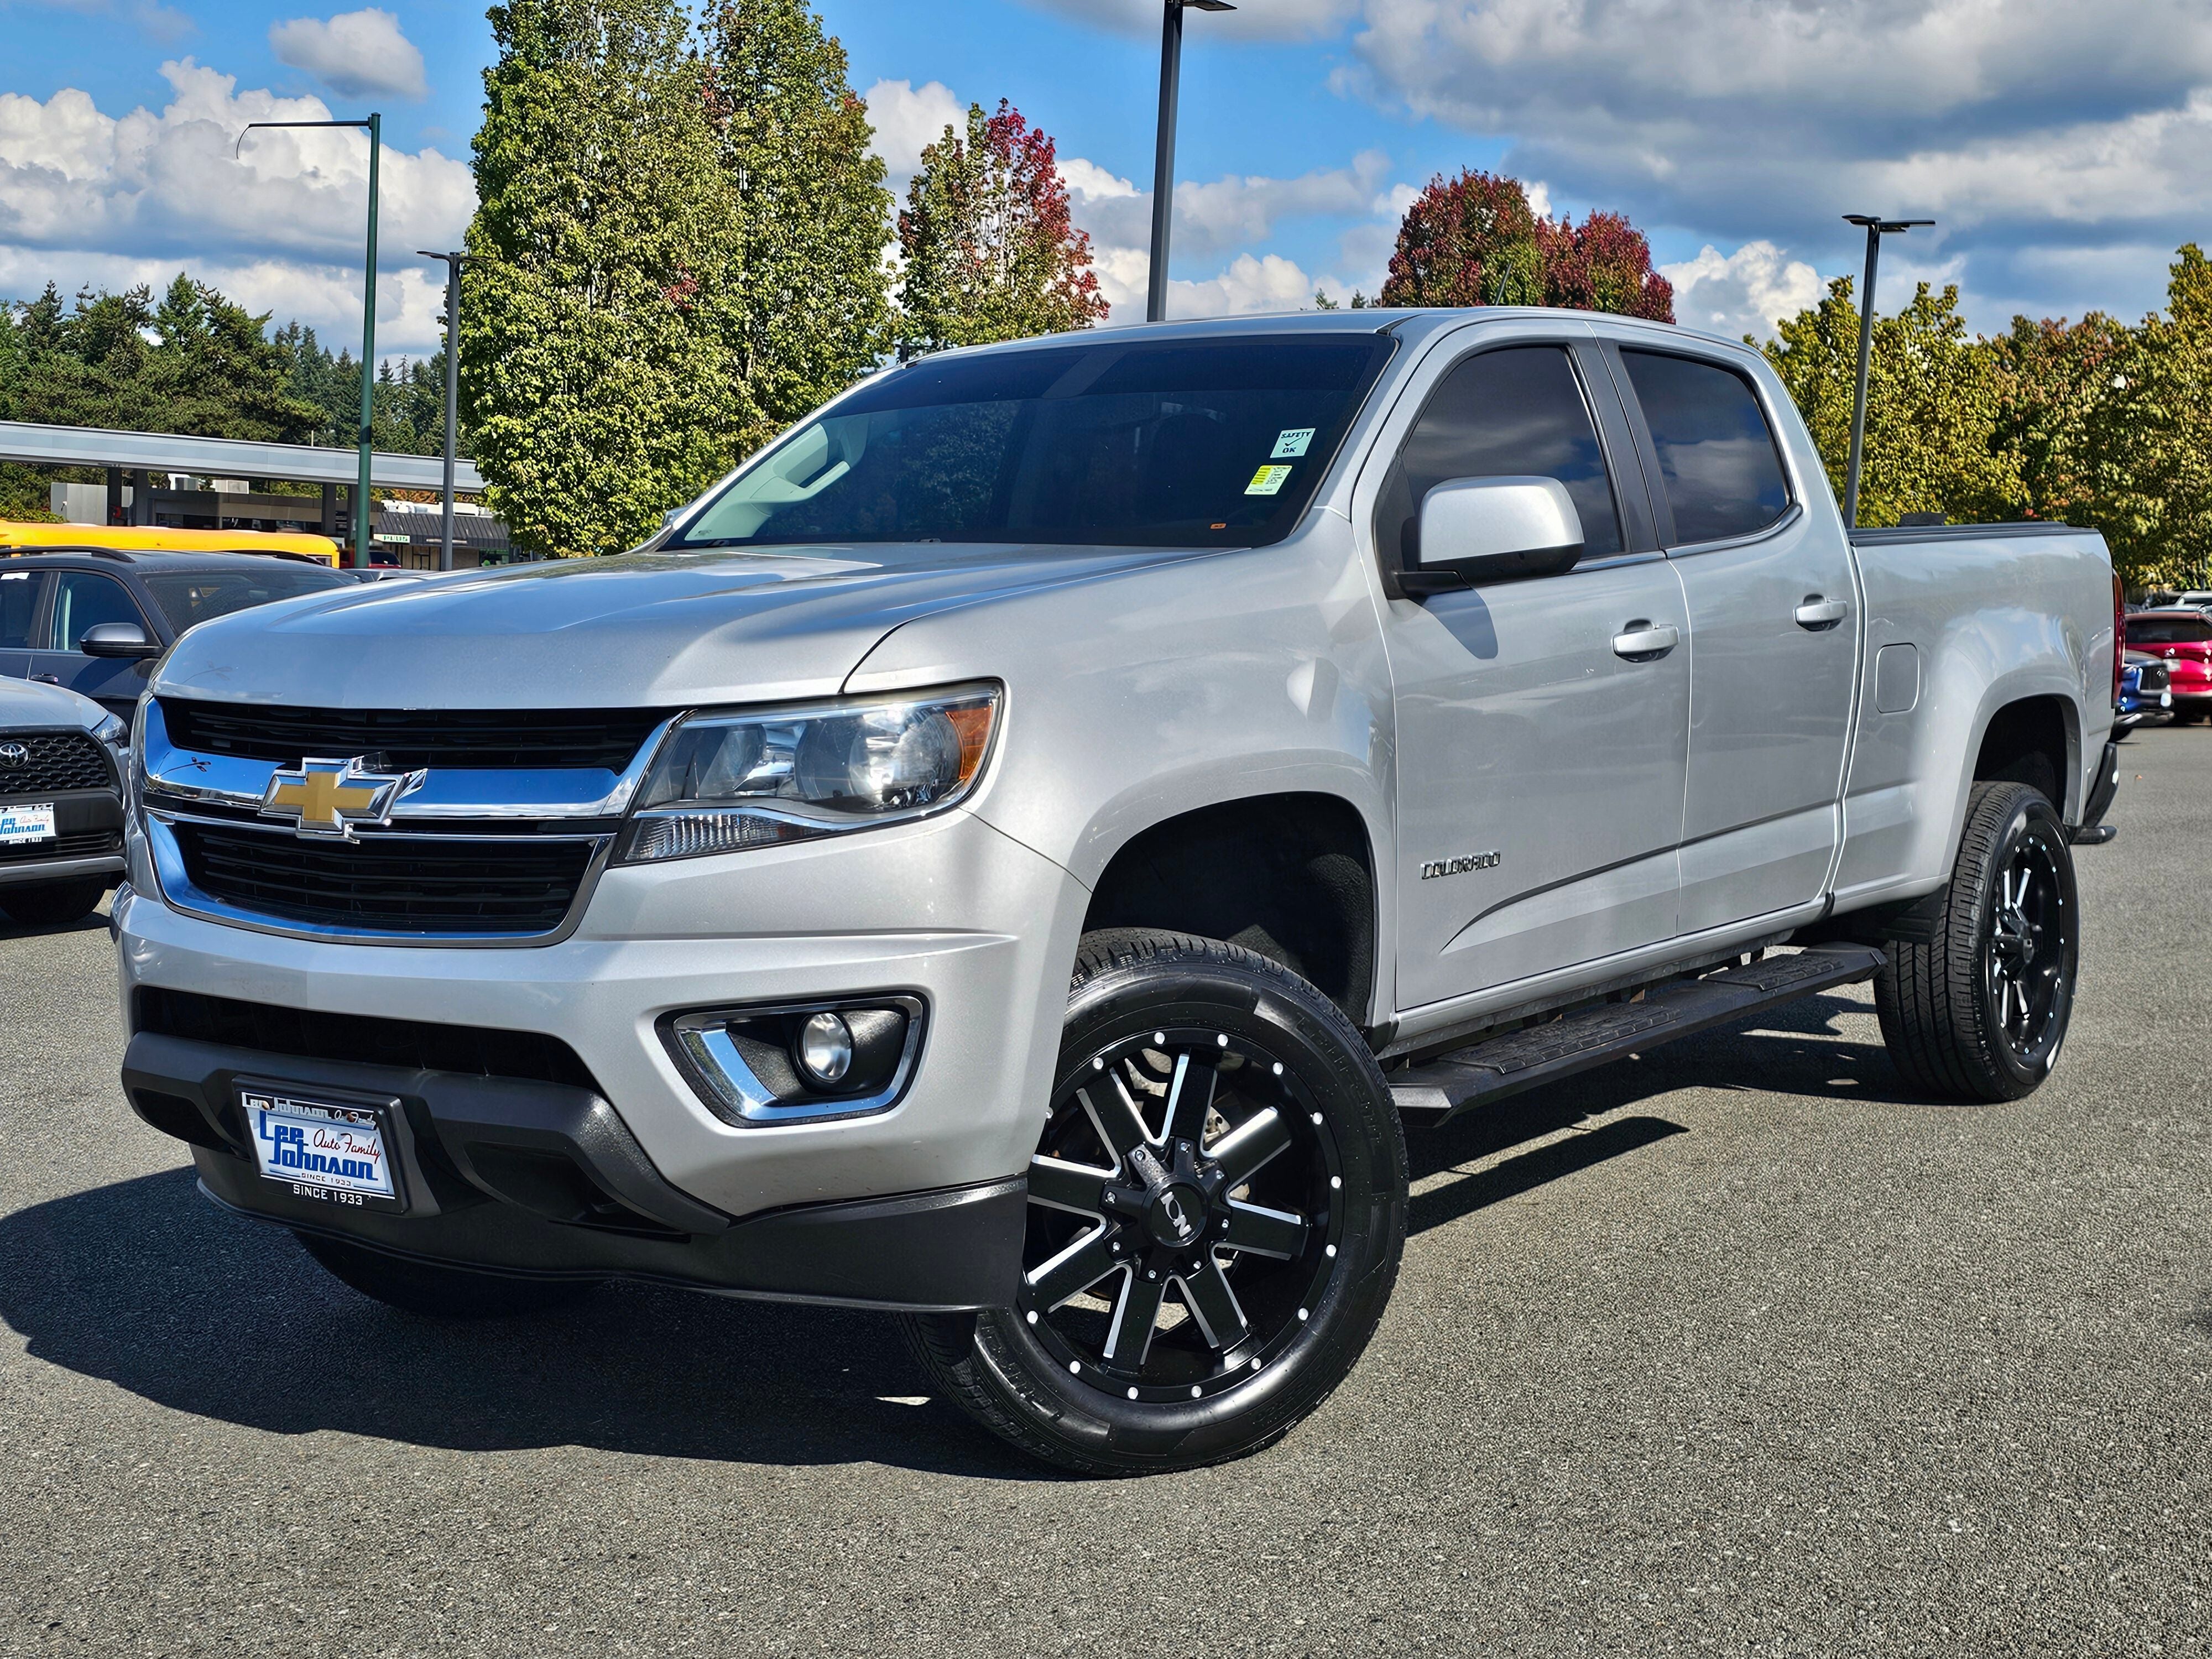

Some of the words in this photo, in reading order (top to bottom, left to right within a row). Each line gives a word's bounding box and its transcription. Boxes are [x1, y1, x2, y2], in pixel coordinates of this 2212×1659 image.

[1420, 849, 1500, 880] COLORADO
[259, 1110, 304, 1143] Lee
[268, 1141, 378, 1181] Johnson
[313, 1129, 341, 1150] Auto
[341, 1133, 382, 1164] Family
[293, 1184, 328, 1199] SINCE
[333, 1191, 362, 1206] 1933
[301, 1173, 326, 1182] SINCE
[331, 1178, 351, 1186] 1933
[1160, 1191, 1192, 1238] ION
